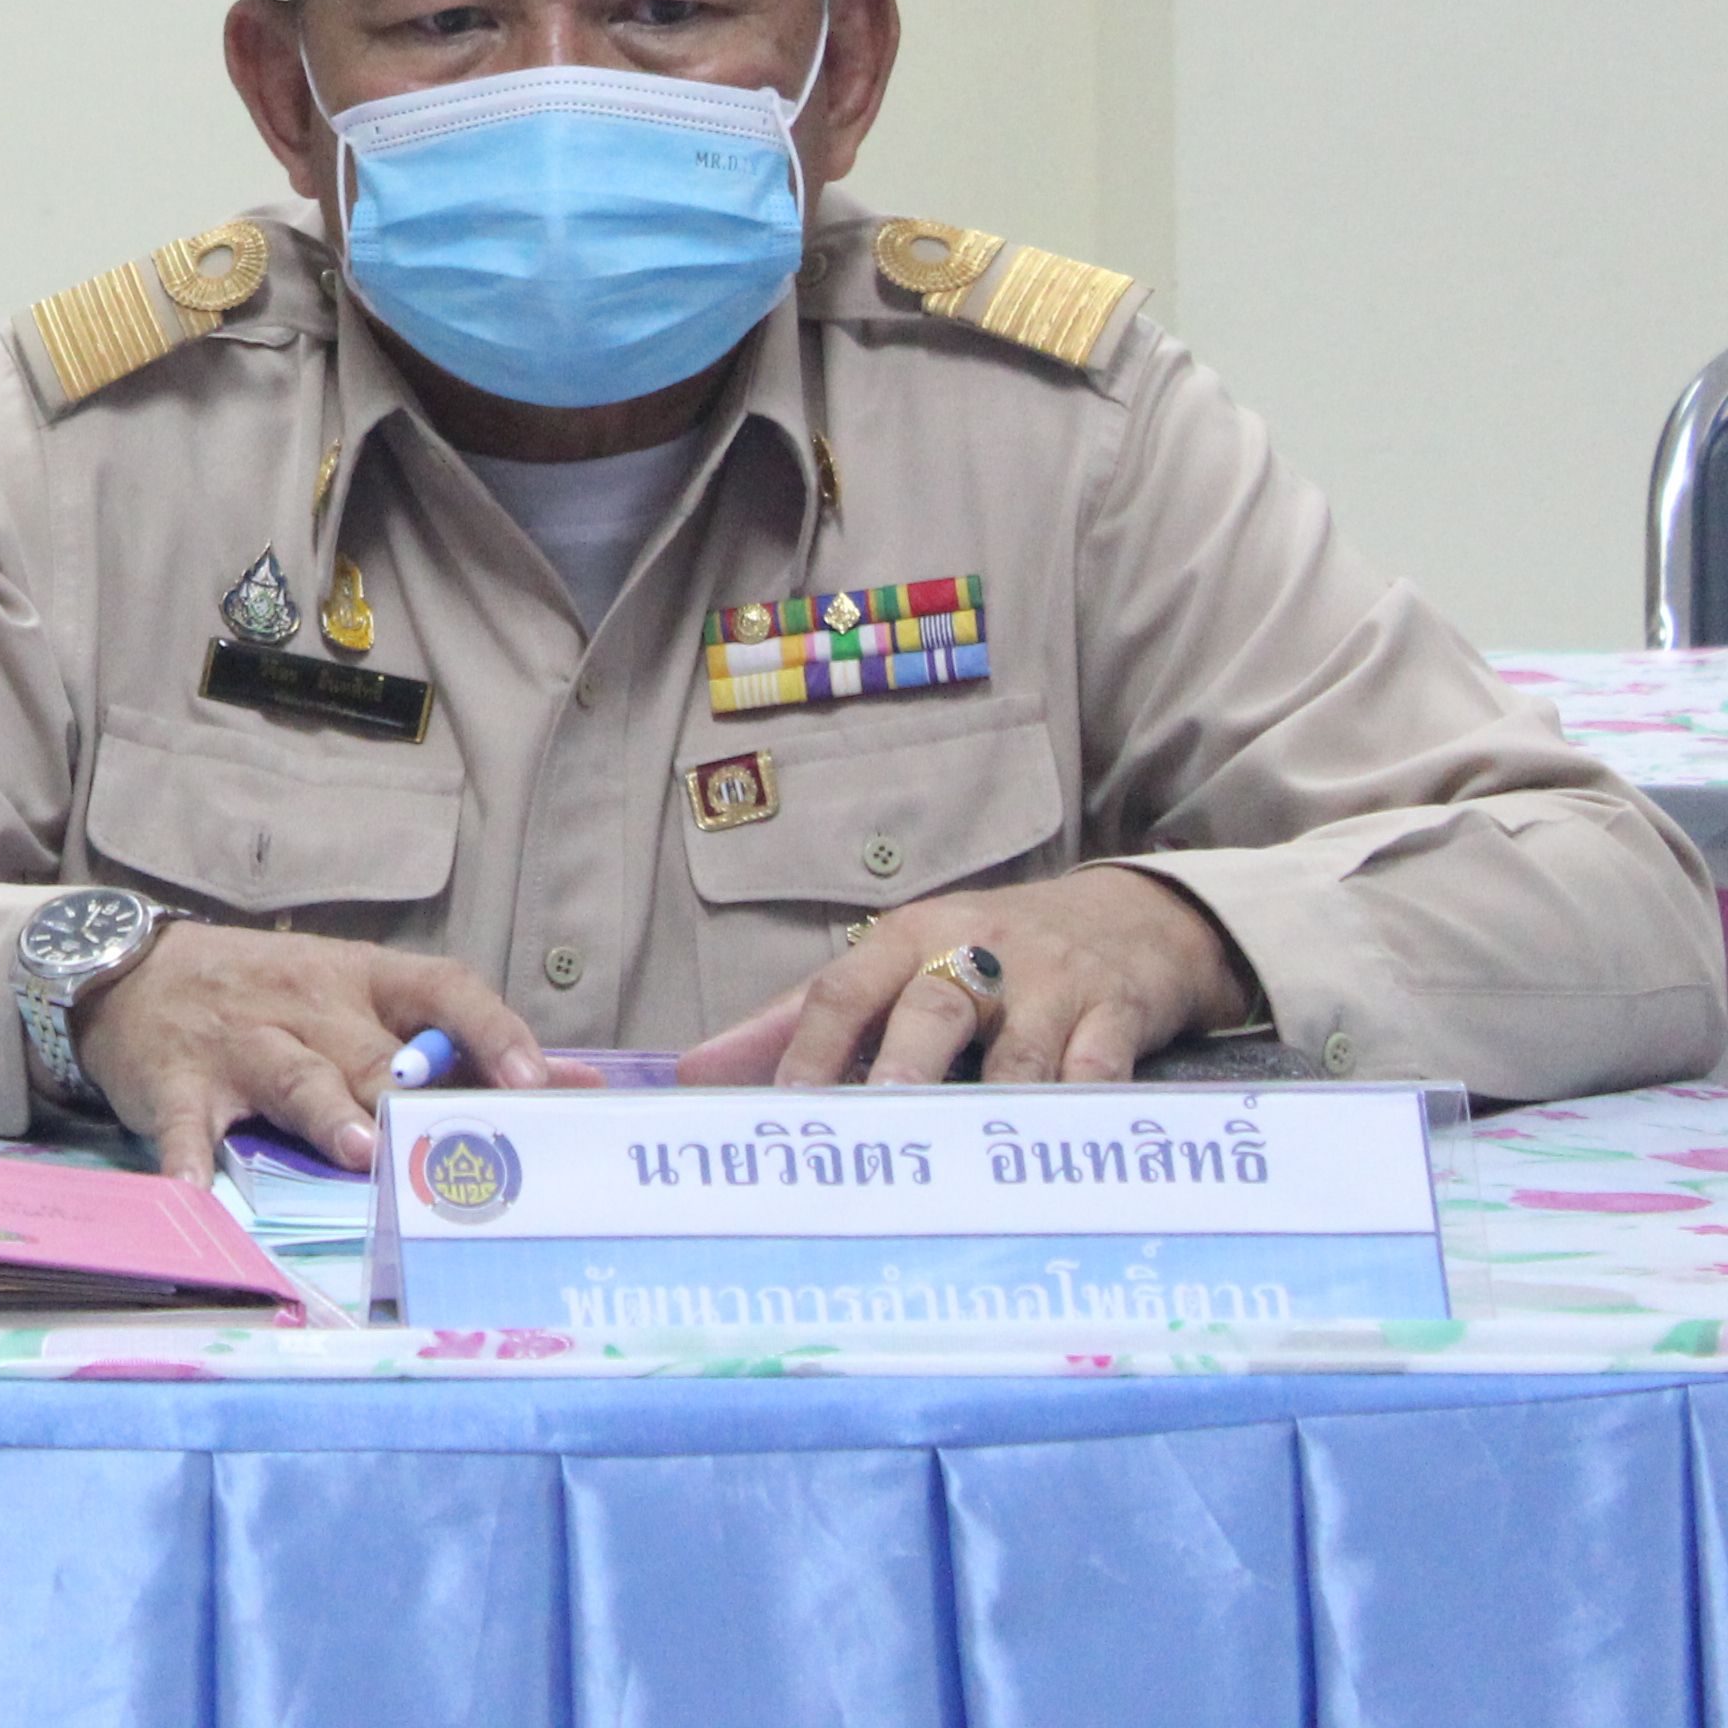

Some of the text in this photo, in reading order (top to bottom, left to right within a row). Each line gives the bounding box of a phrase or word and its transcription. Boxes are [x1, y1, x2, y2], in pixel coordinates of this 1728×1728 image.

[695, 151, 750, 174] MR.D
[627, 1093, 1269, 1187] นายวิจิตร อินทสิทธิ์
[561, 1240, 1291, 1326] พัฒนาการอำเภอโพธิ์ตาก
